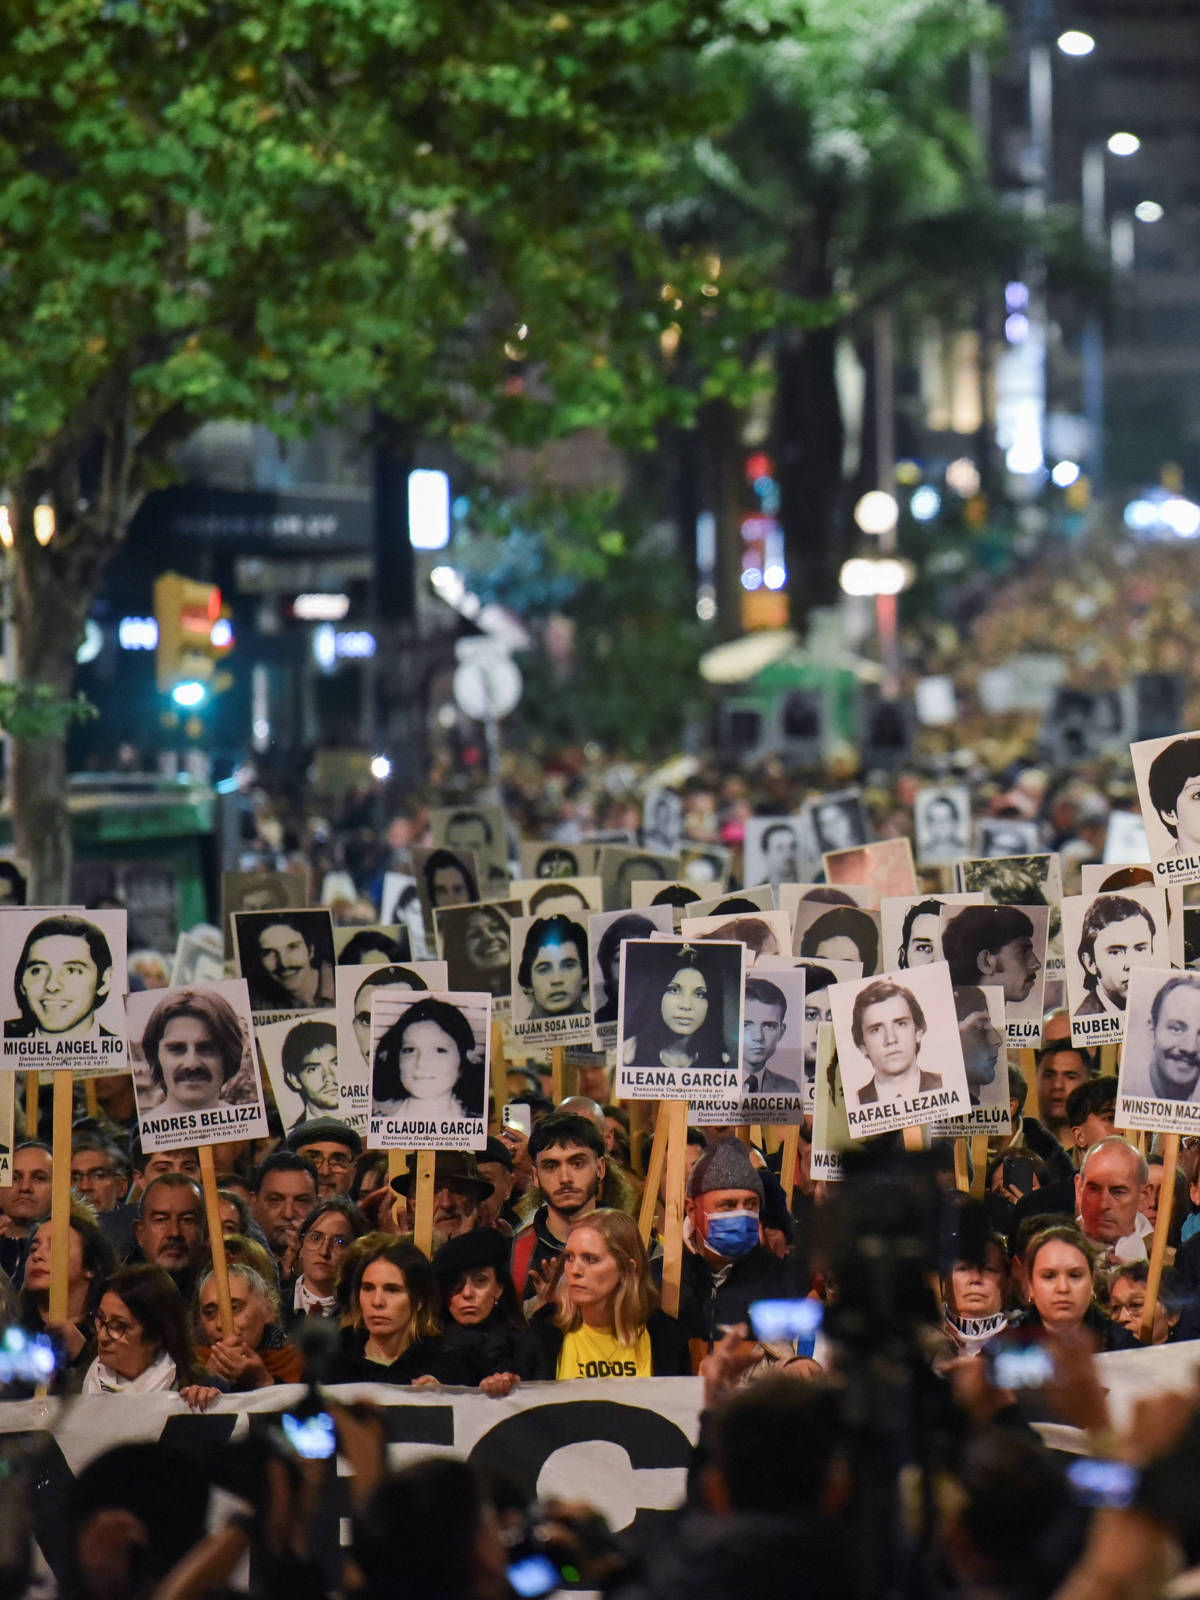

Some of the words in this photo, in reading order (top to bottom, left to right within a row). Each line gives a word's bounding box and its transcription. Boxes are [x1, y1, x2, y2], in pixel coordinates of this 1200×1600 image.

[544, 1019, 567, 1032] SOSA
[1005, 1021, 1040, 1037] ELÚA
[1072, 1017, 1120, 1035] RUBEN
[4, 1041, 51, 1055] MIGUEL
[56, 1040, 98, 1054] ANGEL
[102, 1037, 123, 1053] RÍO
[621, 1071, 677, 1085] ILEANA
[681, 1070, 738, 1087] GARCÍA
[742, 1097, 802, 1111] AROCENA
[848, 1103, 901, 1125] RAFAEL
[904, 1091, 960, 1113] LEZAMA
[1122, 1099, 1173, 1117] WINSTON
[142, 1114, 197, 1134] ANDRES
[201, 1106, 262, 1126] BELLIZZI
[968, 1106, 1010, 1123] PELÚA
[386, 1120, 437, 1135] CLAUDIA
[440, 1118, 484, 1135] GARCÍA
